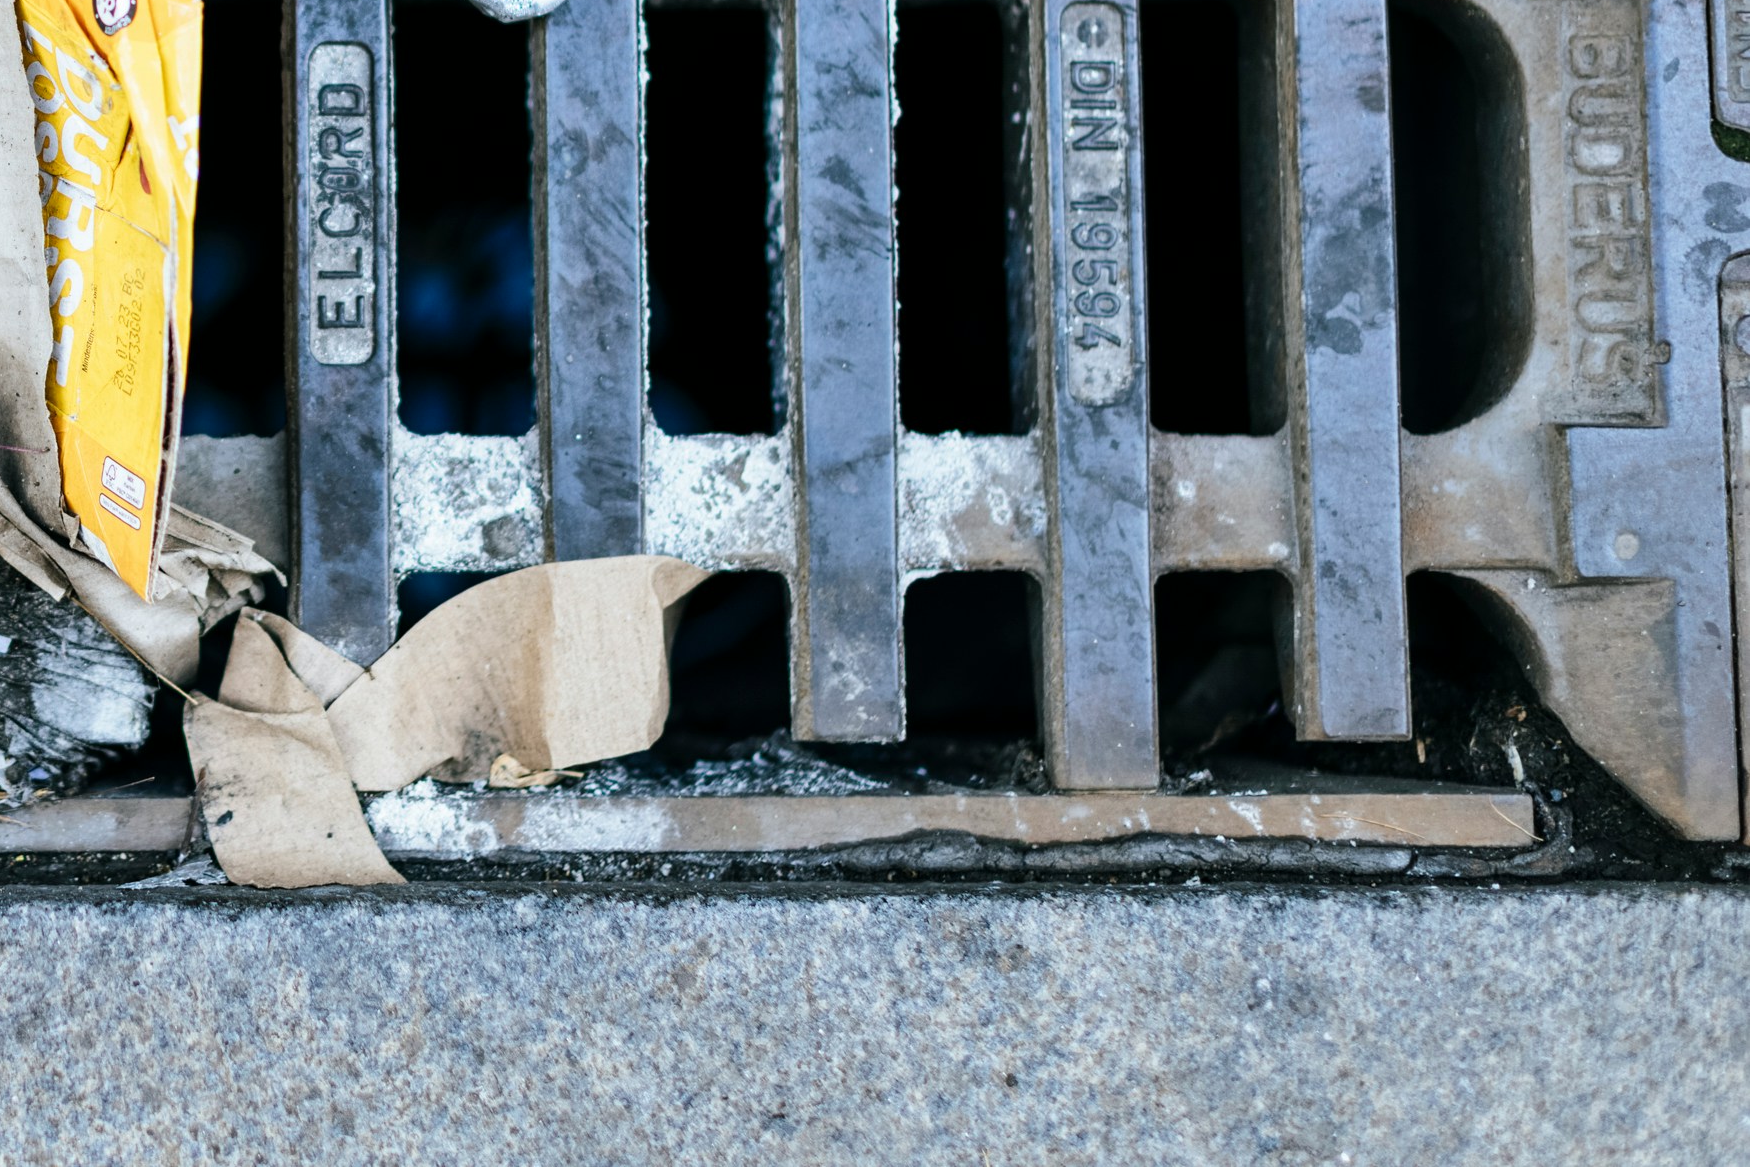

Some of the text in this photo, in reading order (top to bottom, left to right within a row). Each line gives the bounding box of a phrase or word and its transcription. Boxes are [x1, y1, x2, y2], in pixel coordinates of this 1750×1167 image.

[123, 271, 132, 296] BC
[316, 82, 366, 330] ELCORD
[1068, 60, 1121, 349] DIN 19594
[1567, 33, 1642, 385] BUDERUS
